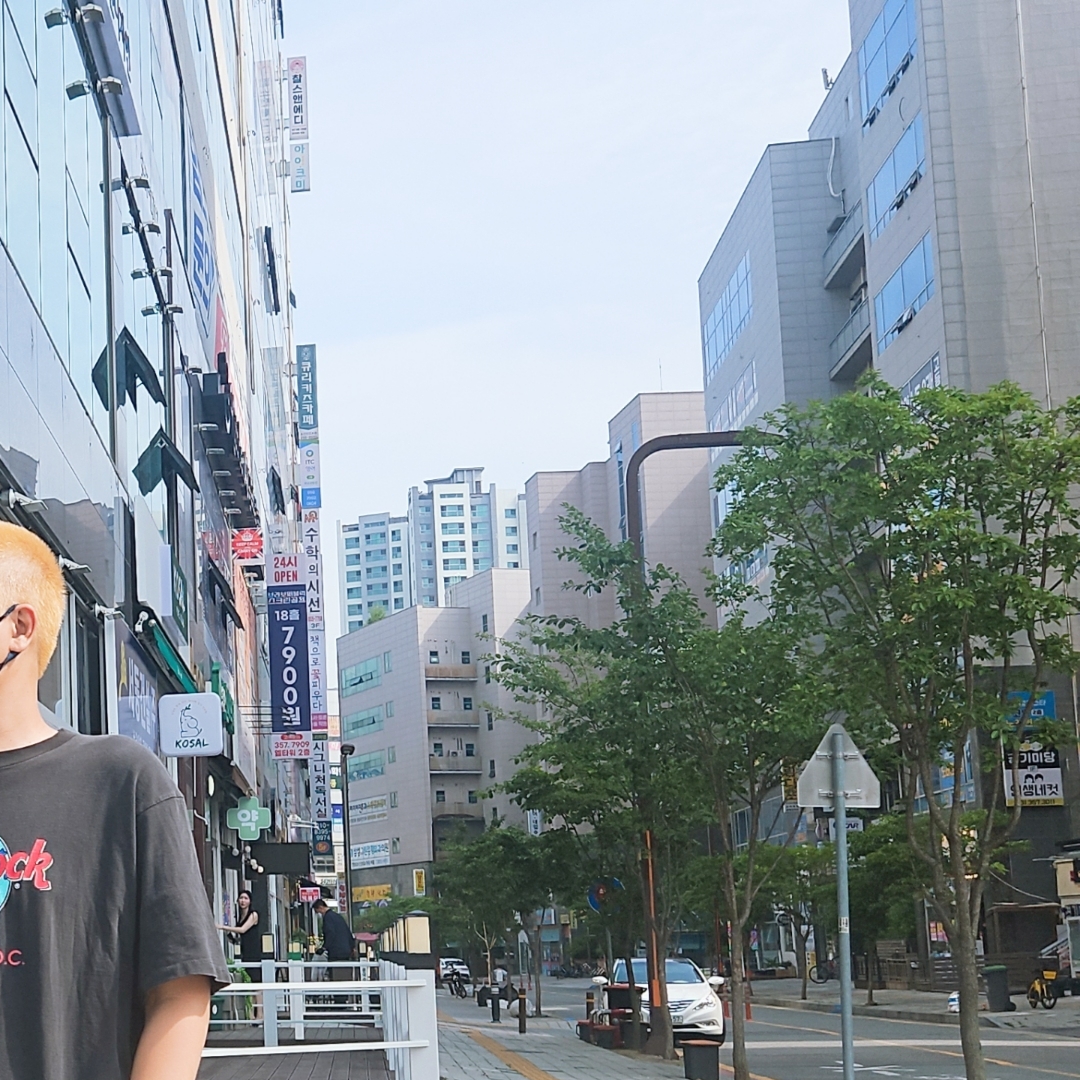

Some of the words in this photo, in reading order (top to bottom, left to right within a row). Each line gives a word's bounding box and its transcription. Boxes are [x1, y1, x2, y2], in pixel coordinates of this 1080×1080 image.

[274, 556, 298, 568] 24시
[274, 570, 298, 582] OPEN
[275, 610, 300, 621] 18홀
[175, 739, 209, 748] KOSAL
[312, 741, 327, 819] 시그니처독서실
[237, 809, 259, 831] 약
